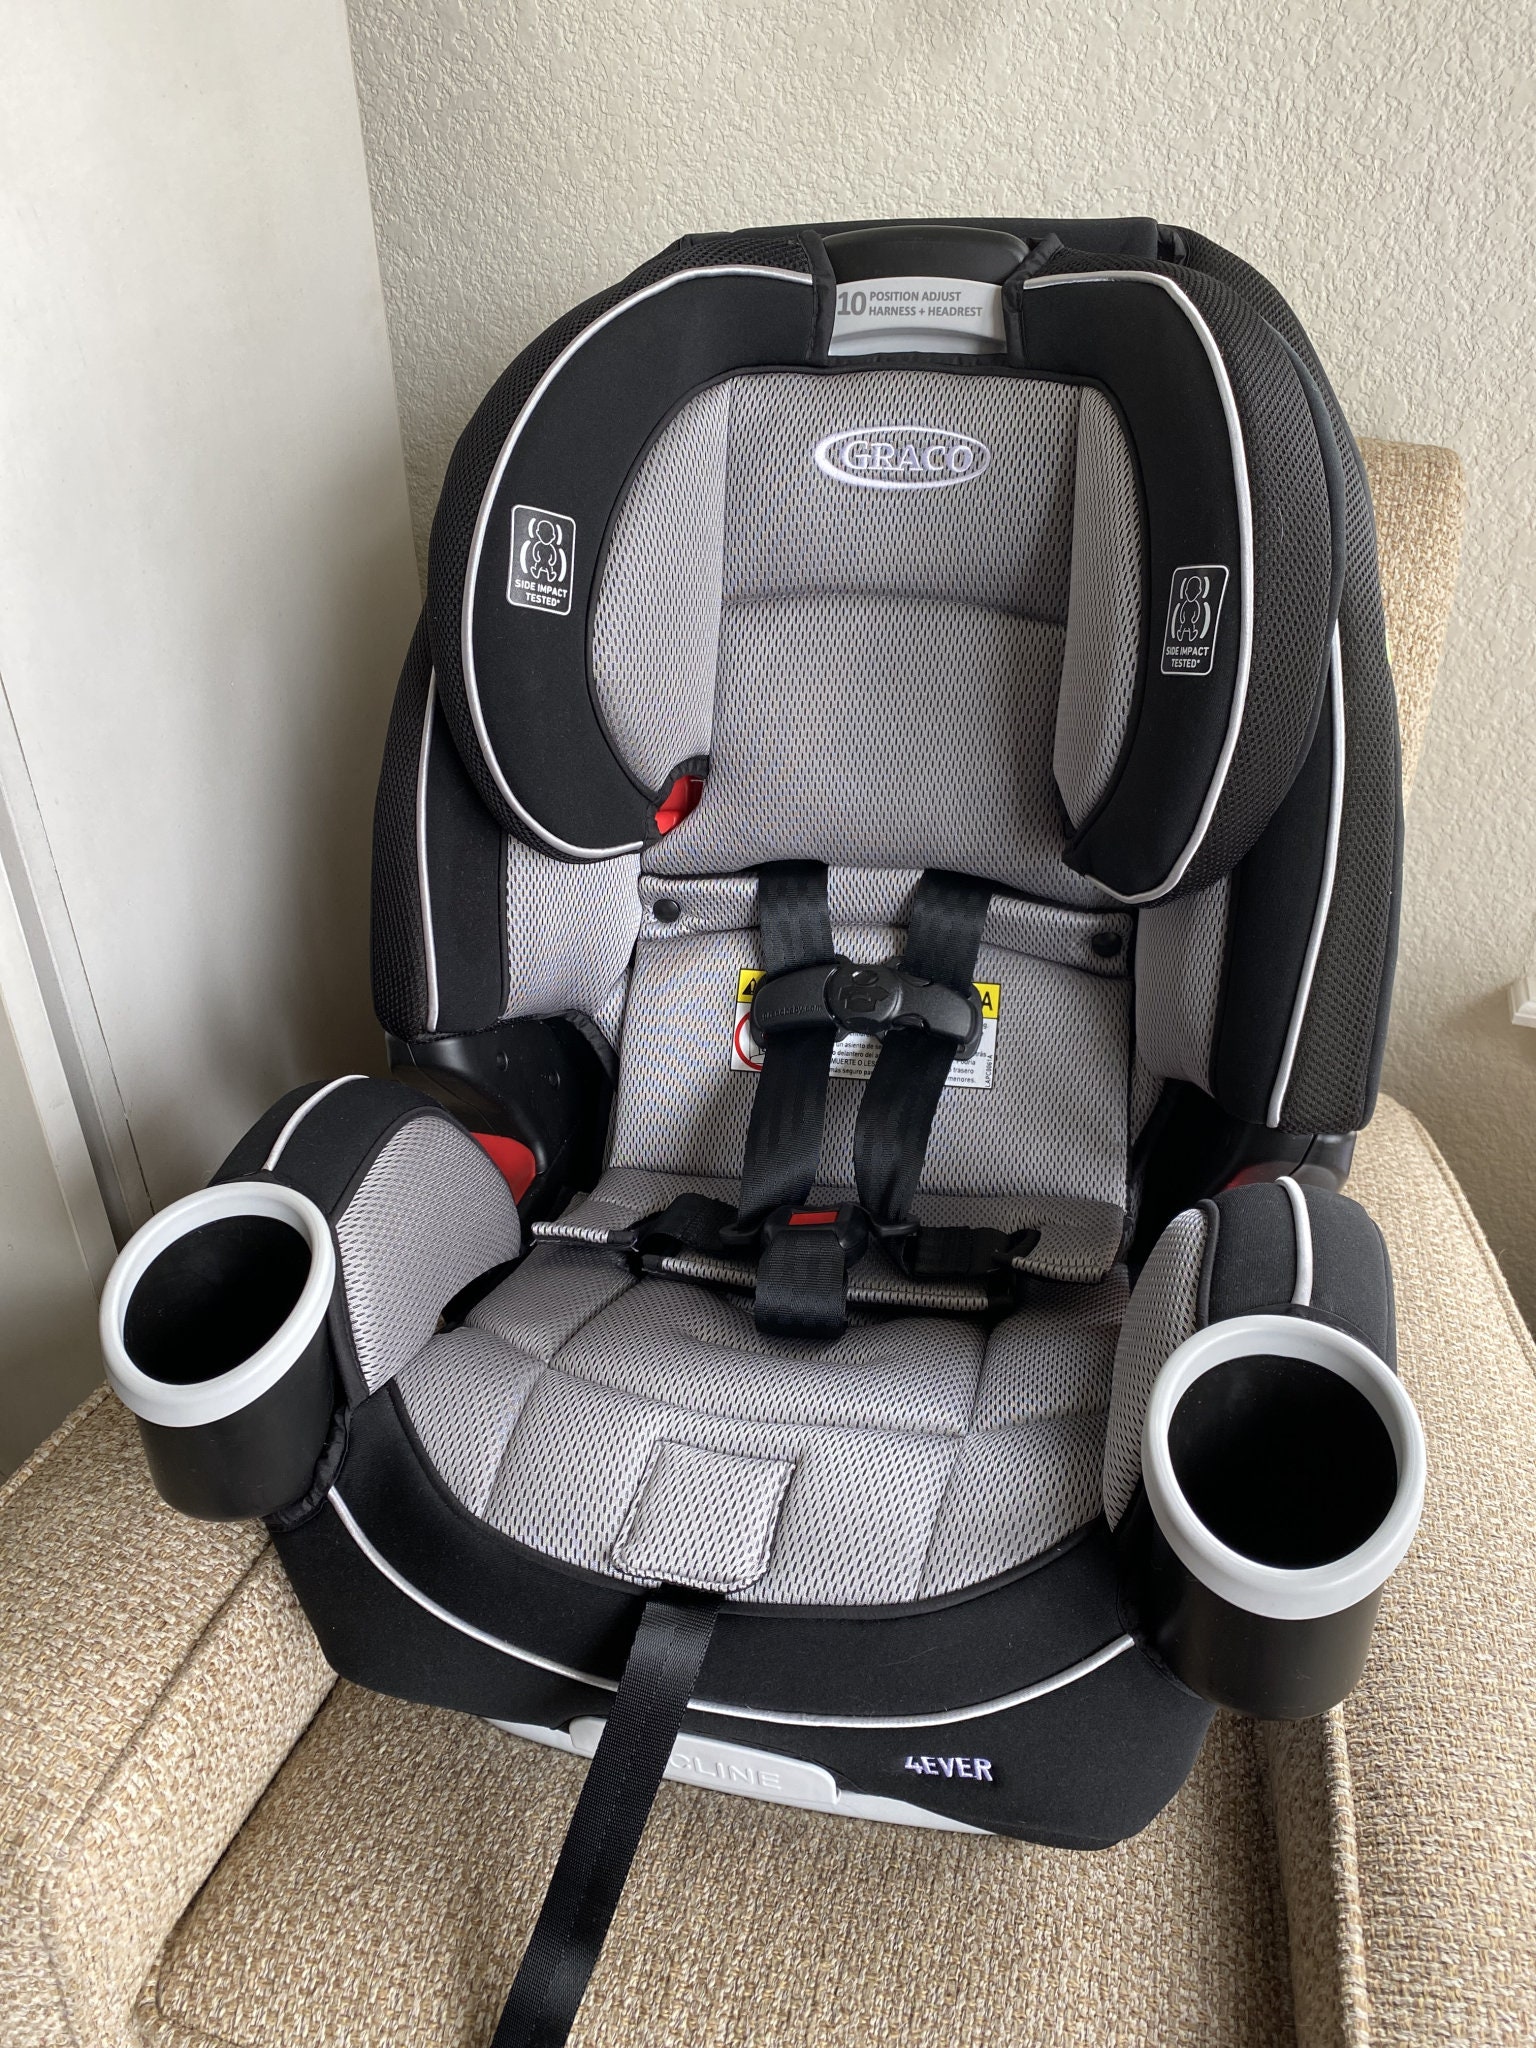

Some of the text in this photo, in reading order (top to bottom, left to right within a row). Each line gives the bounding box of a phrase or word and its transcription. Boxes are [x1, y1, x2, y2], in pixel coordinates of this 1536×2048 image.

[837, 291, 867, 316] 10
[869, 291, 962, 302] POSITION ADJUST
[868, 306, 983, 317] HARNESS + HEADREST
[841, 440, 973, 473] GRACO
[514, 579, 568, 598] SIDE IMPACT
[1165, 646, 1210, 656] SIDE IMPACT
[837, 1050, 863, 1058] delantero
[830, 1058, 856, 1066] MUERTE
[669, 1753, 782, 1791] CLINE
[904, 1755, 994, 1782] 4EVER
